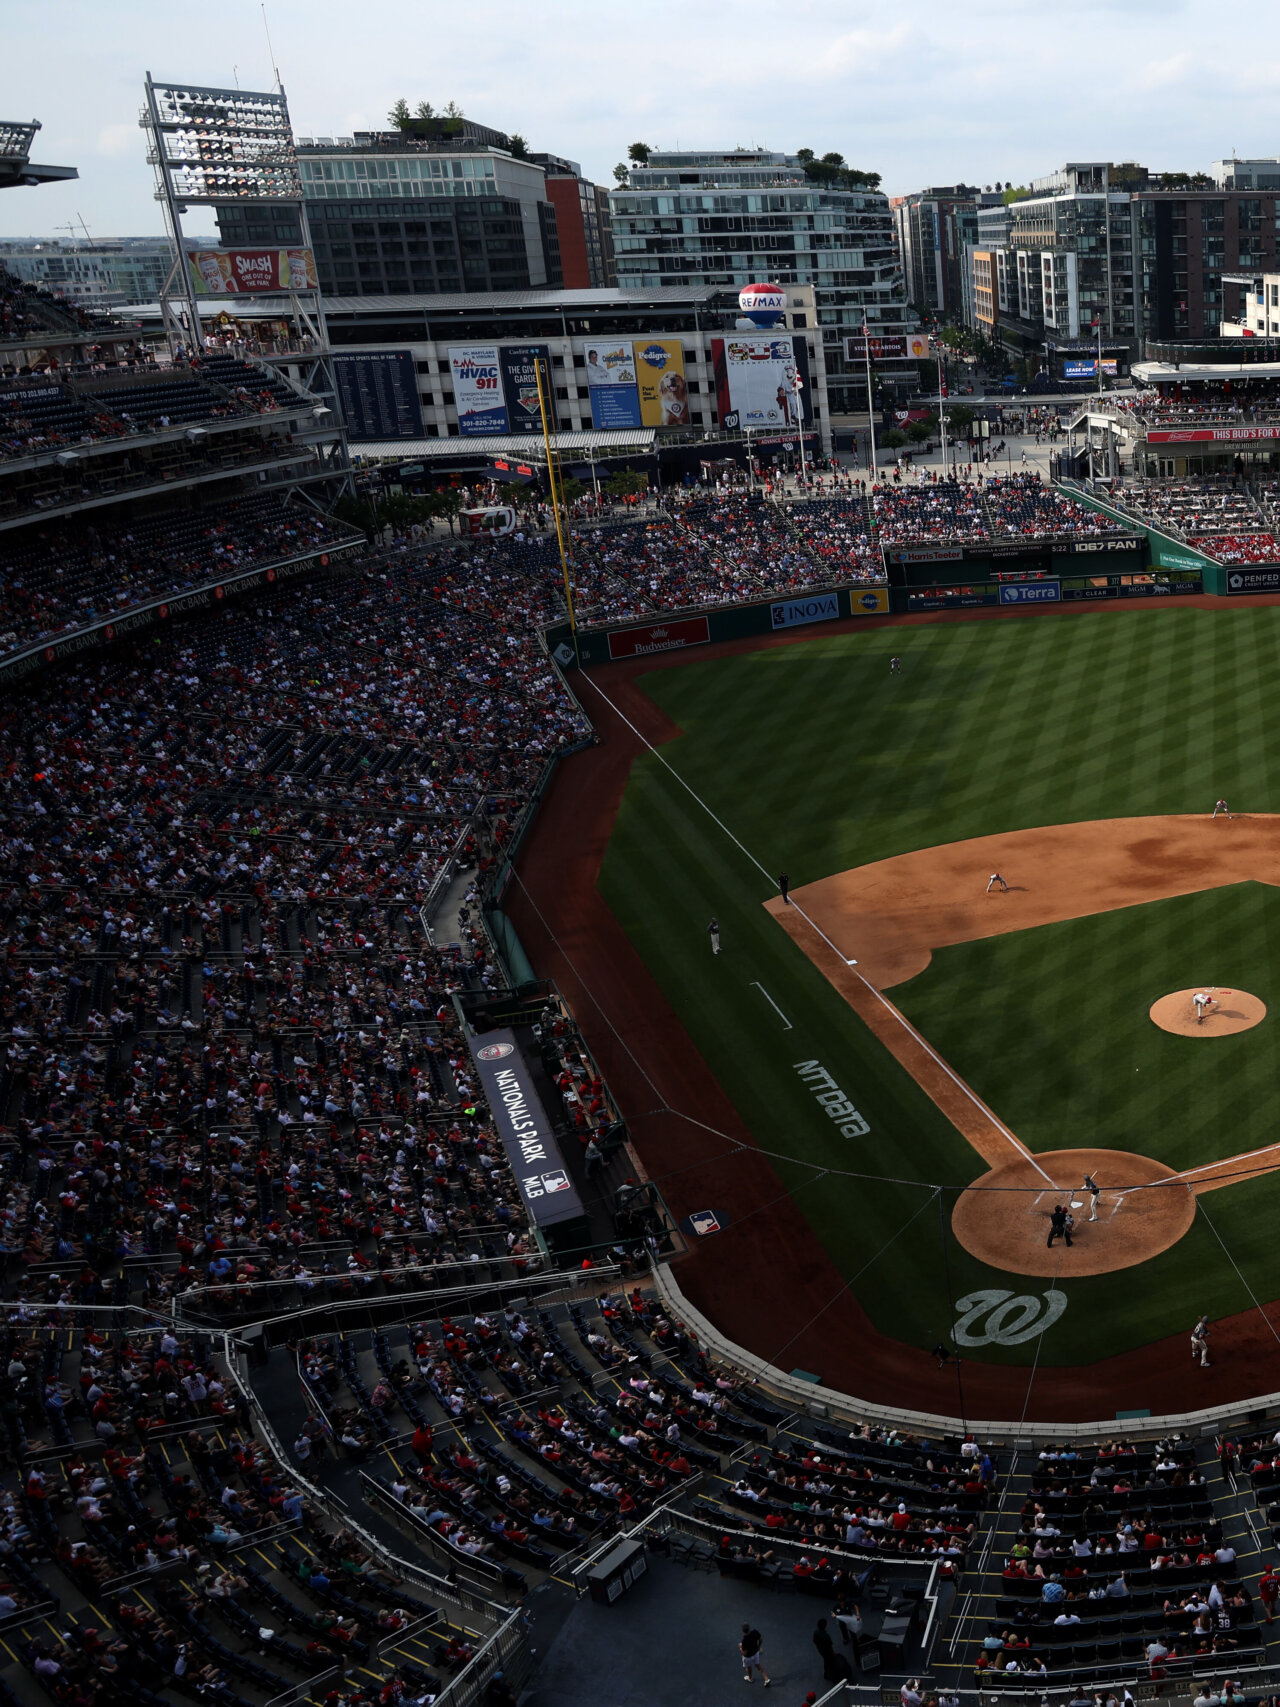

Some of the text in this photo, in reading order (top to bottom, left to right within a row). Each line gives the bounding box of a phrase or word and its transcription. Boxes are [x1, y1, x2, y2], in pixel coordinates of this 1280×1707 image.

[235, 255, 273, 274] SMASH
[742, 296, 782, 307] RE/MAX
[638, 351, 672, 360] Pedigree
[459, 367, 498, 379] HVAC
[507, 365, 521, 374] THE
[476, 378, 498, 389] 911
[514, 375, 537, 384] GARDE
[1212, 430, 1231, 439] THIS
[1232, 429, 1257, 438] BUD'S
[1258, 428, 1274, 437] FOR
[1107, 540, 1137, 550] FAN
[907, 553, 934, 561] Harris
[934, 551, 961, 560] Teeter
[1244, 573, 1279, 582] PENFED
[1020, 587, 1055, 599] Terra
[1128, 582, 1193, 593] MGM MGM
[857, 597, 882, 606] Pedigree
[788, 600, 838, 620] INOVA
[634, 637, 686, 654] Budweiser
[494, 1069, 547, 1165] NATIONALS PARK
[521, 1175, 546, 1200] MLB
[1218, 1618, 1230, 1628] 38
